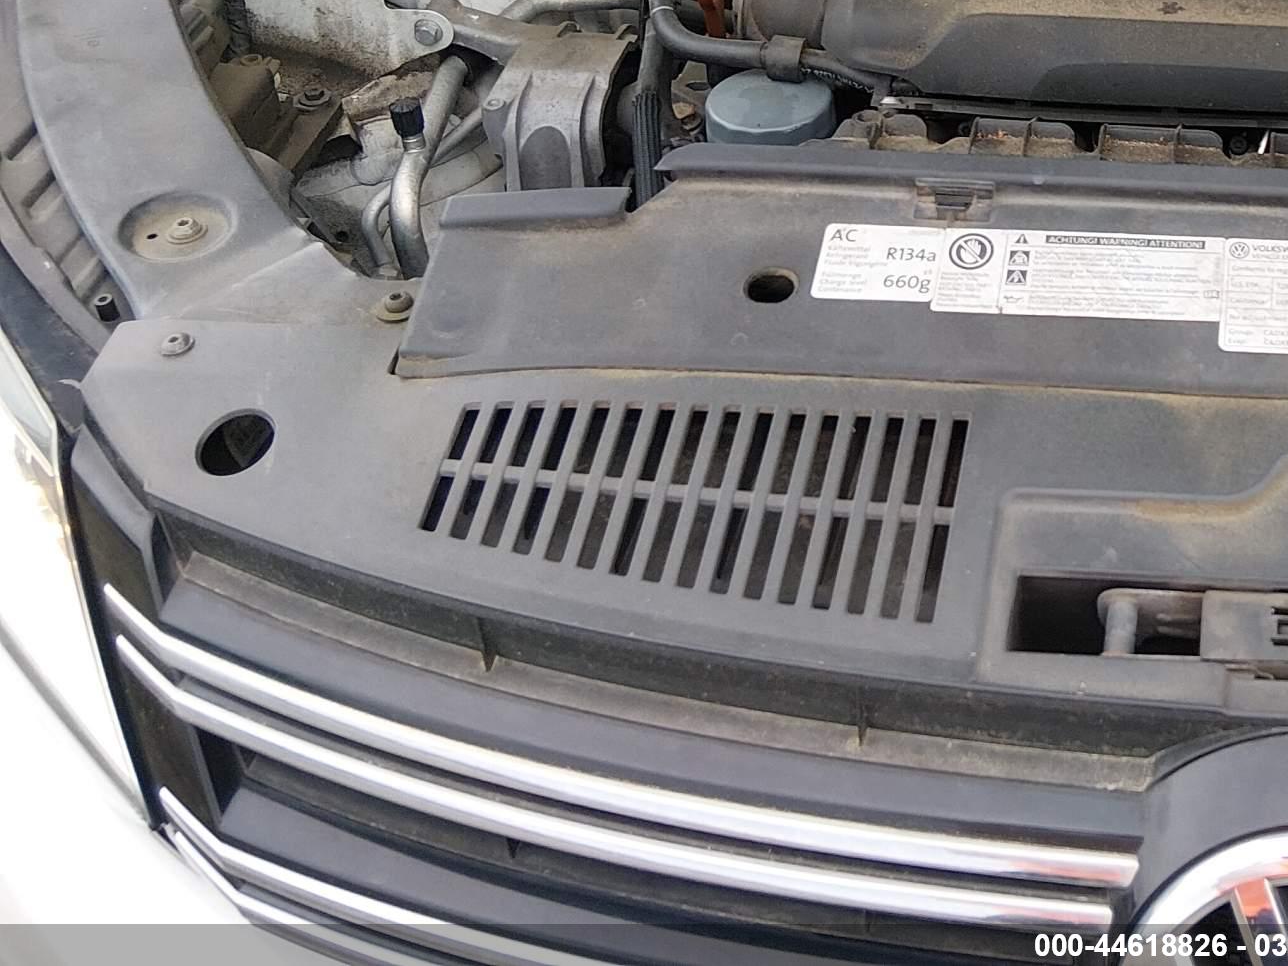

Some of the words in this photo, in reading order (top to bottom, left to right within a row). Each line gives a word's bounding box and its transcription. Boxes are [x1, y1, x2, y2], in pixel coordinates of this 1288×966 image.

[830, 228, 859, 242] AC
[886, 247, 936, 263] R134a
[883, 274, 931, 294] 660g
